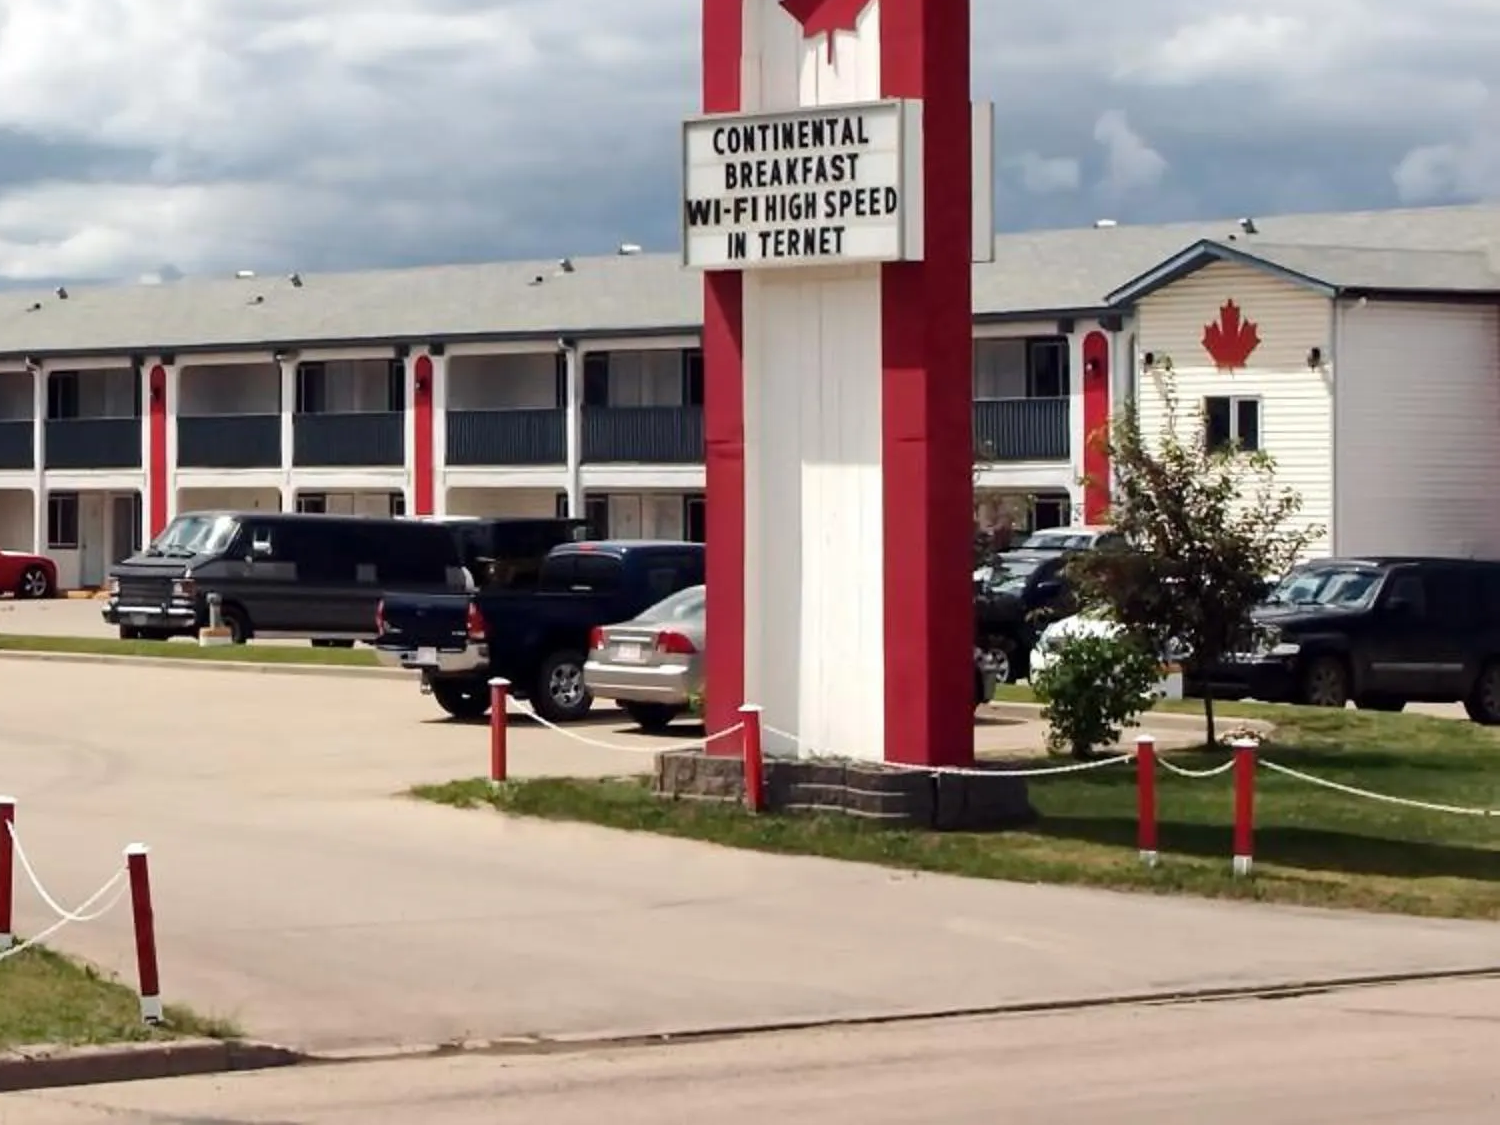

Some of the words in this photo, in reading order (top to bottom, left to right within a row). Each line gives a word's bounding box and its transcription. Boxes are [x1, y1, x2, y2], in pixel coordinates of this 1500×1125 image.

[713, 116, 869, 155] CONTINENTAL
[725, 153, 859, 189] BREAKFAST
[765, 192, 816, 223] HIGH
[824, 186, 897, 217] SPEED
